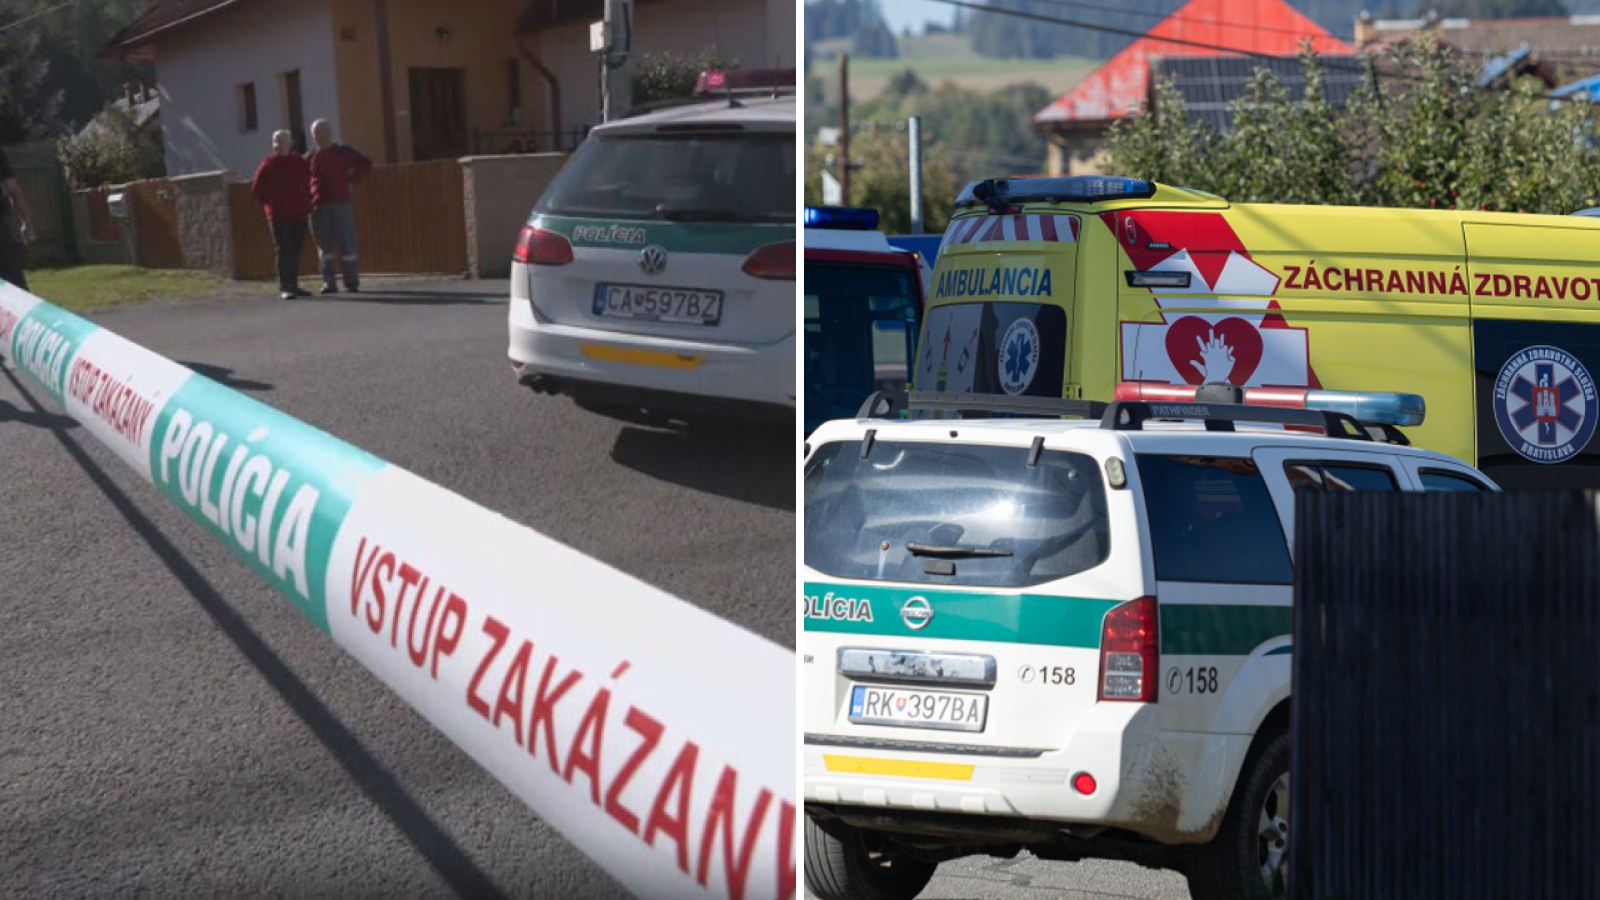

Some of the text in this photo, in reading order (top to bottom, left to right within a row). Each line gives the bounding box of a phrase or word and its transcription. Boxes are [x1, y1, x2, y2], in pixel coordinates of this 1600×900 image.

[572, 223, 646, 245] POLÍCIA
[935, 266, 1052, 299] AMBULANCIA
[1283, 260, 1469, 295] ZÁCHRANNÁ
[608, 288, 717, 318] CA 597BZ
[1152, 404, 1211, 417] PATHFINDER
[1520, 442, 1575, 460] BRATISLAVA
[160, 408, 320, 600] POLÍCIA
[351, 537, 468, 681] VSTUP
[1039, 666, 1075, 686] 158
[1186, 666, 1219, 694] 158
[866, 691, 979, 722] RK 397BA
